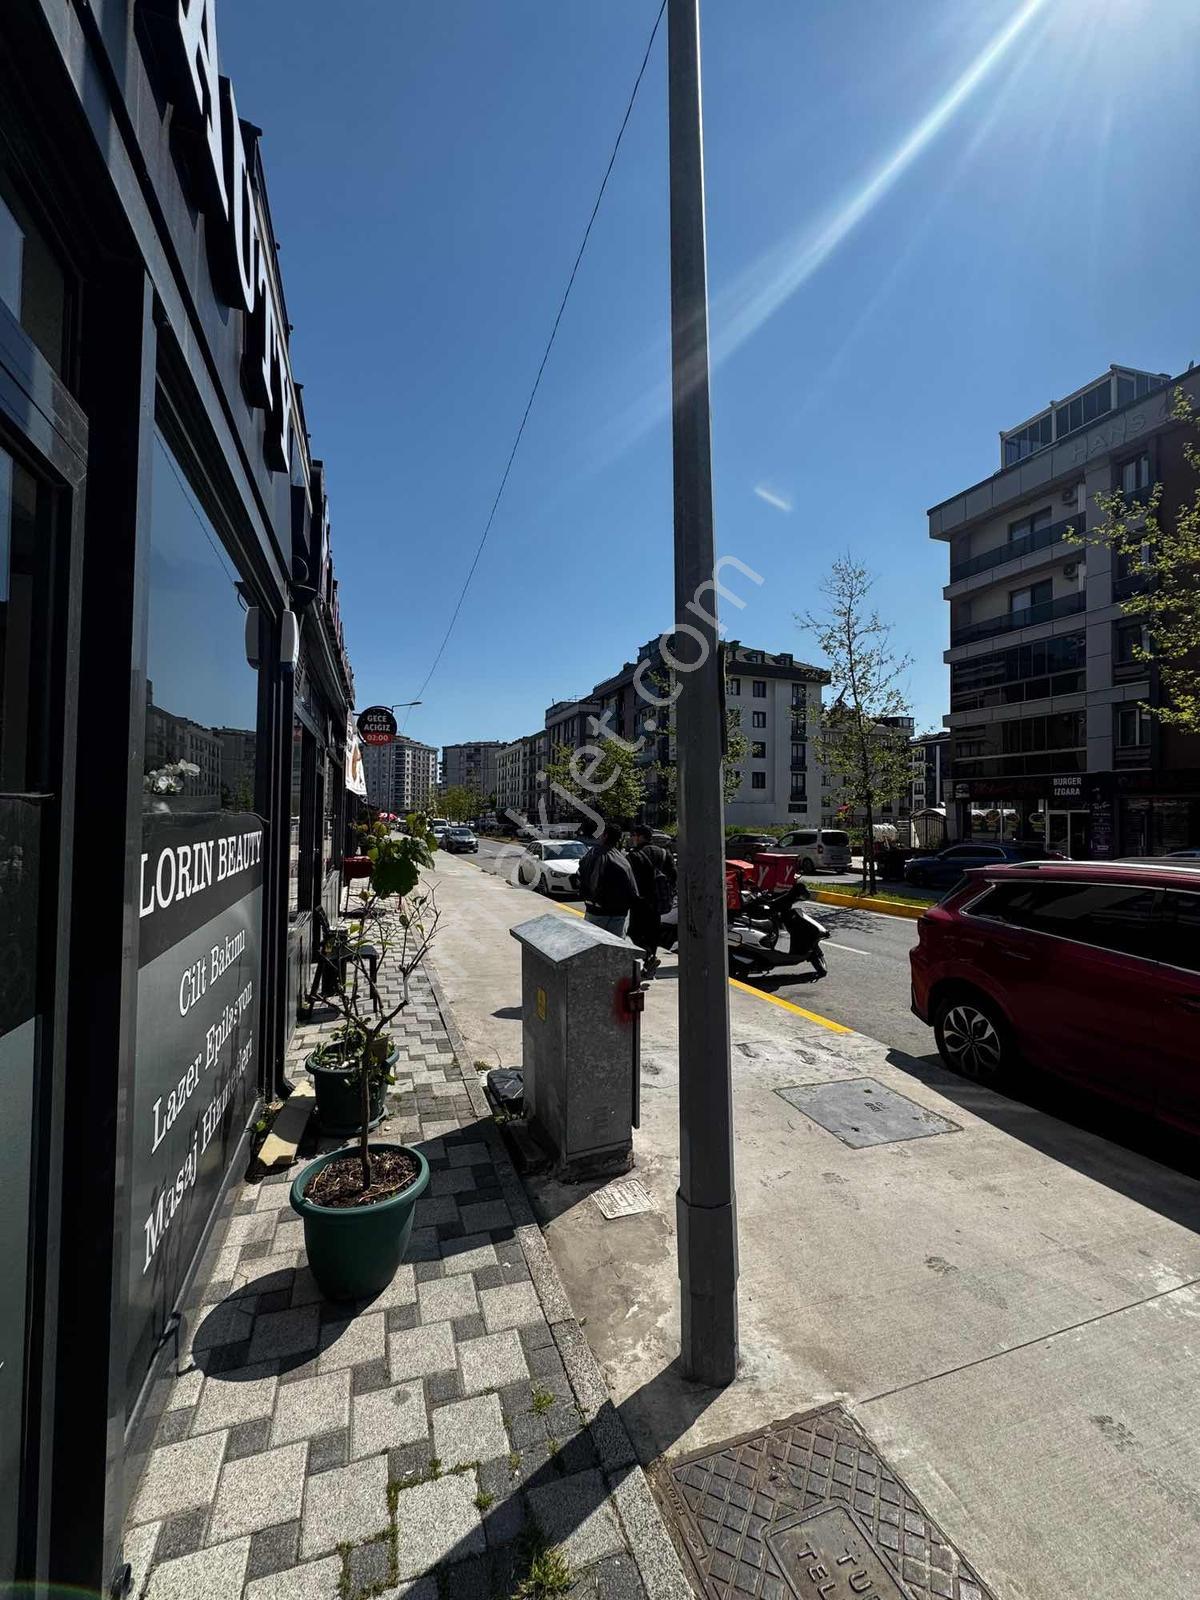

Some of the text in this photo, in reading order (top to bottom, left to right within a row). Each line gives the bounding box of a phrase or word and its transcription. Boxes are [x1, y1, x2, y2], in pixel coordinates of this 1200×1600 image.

[367, 715, 387, 723] GECE
[1053, 777, 1082, 786] BURGER
[139, 830, 263, 918] LORIN BEAUTY
[179, 955, 207, 1017] Cilt
[151, 980, 253, 1155] Lazer Epilasyon
[142, 1130, 198, 1275] Masaj
